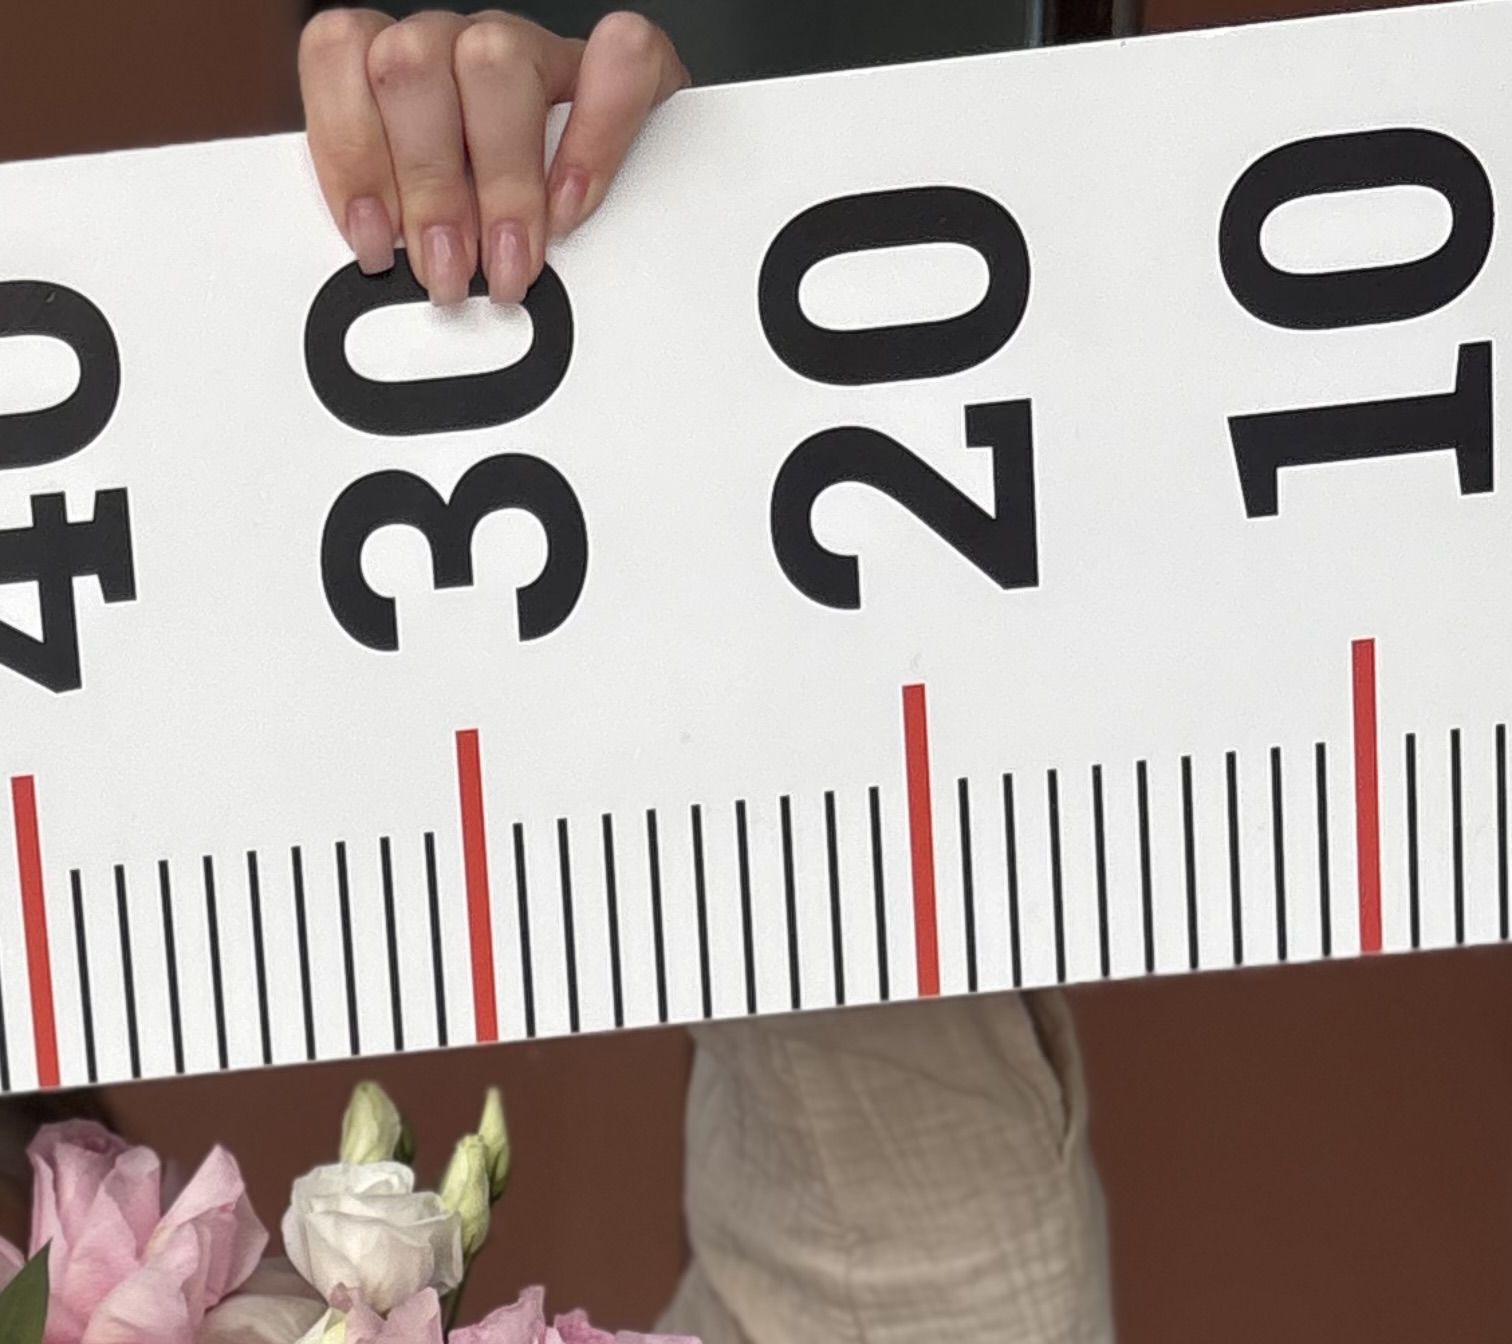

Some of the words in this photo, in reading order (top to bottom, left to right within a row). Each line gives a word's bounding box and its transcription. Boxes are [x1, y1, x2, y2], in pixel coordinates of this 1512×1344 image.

[304, 247, 589, 651] 30
[757, 185, 1039, 610] 20
[1218, 127, 1495, 518] 10
